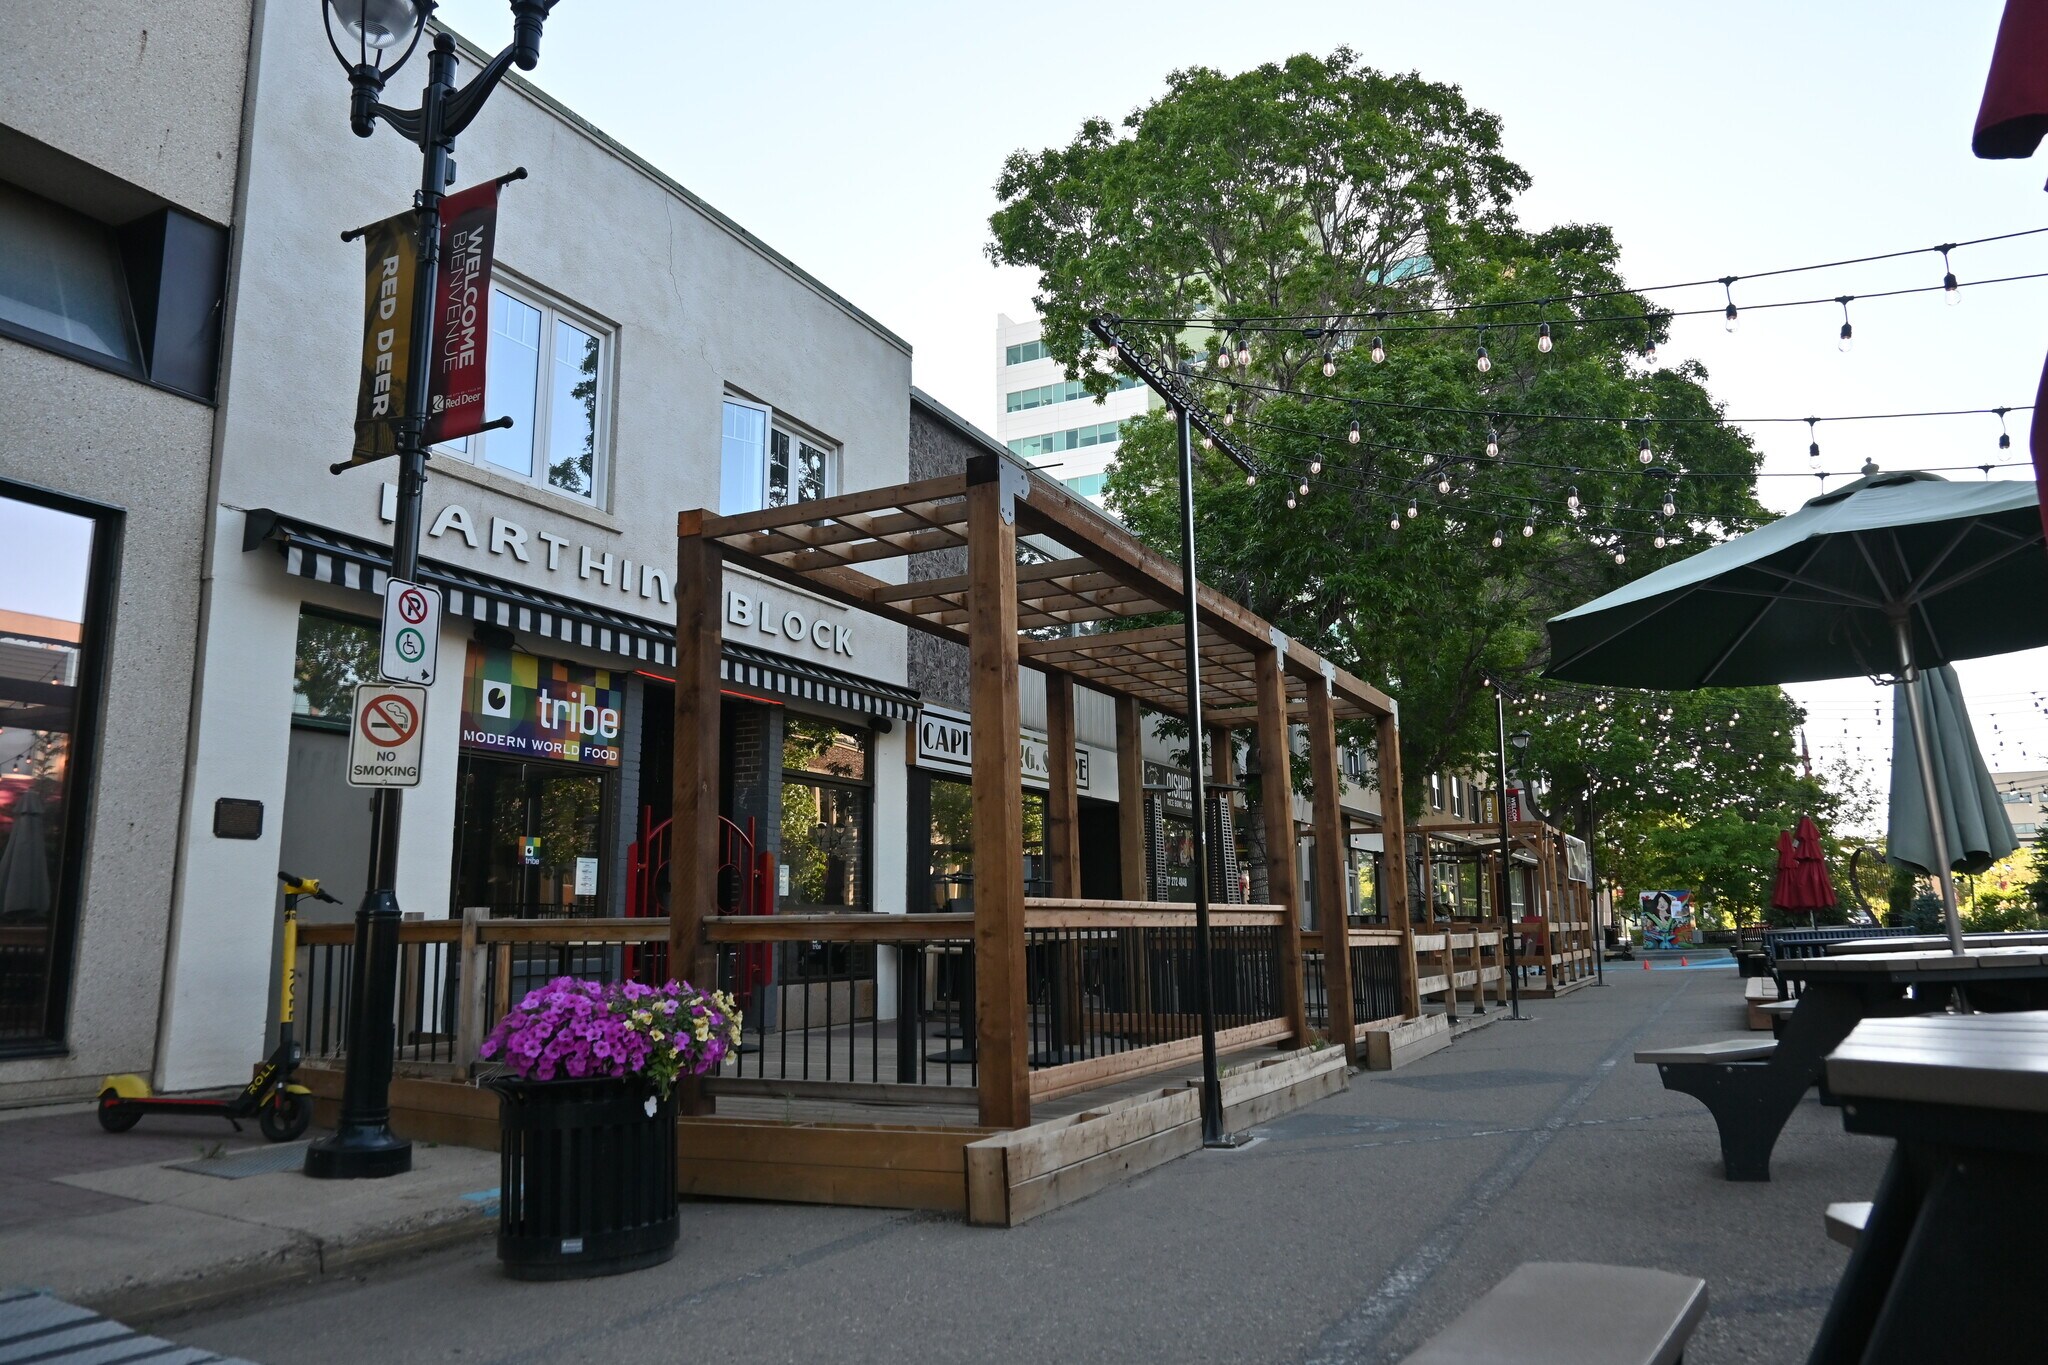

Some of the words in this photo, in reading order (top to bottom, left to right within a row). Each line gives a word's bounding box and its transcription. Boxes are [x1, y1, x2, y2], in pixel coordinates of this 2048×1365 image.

[380, 255, 399, 320] RED
[443, 231, 467, 373] BIENVENUE
[459, 225, 484, 369] WELCOME
[372, 329, 394, 418] DEER
[445, 396, 460, 409] Red
[461, 393, 481, 404] Deer
[728, 591, 854, 657] BLOCK
[540, 688, 620, 739] tribe
[464, 730, 526, 748] MODERN
[532, 739, 580, 755] WORLD
[585, 747, 618, 761] FOOD
[923, 722, 971, 756] CAPI
[354, 765, 417, 777] SMOKING
[376, 751, 396, 762] NO
[525, 857, 540, 865] tribe
[247, 1064, 276, 1095] ROLL
